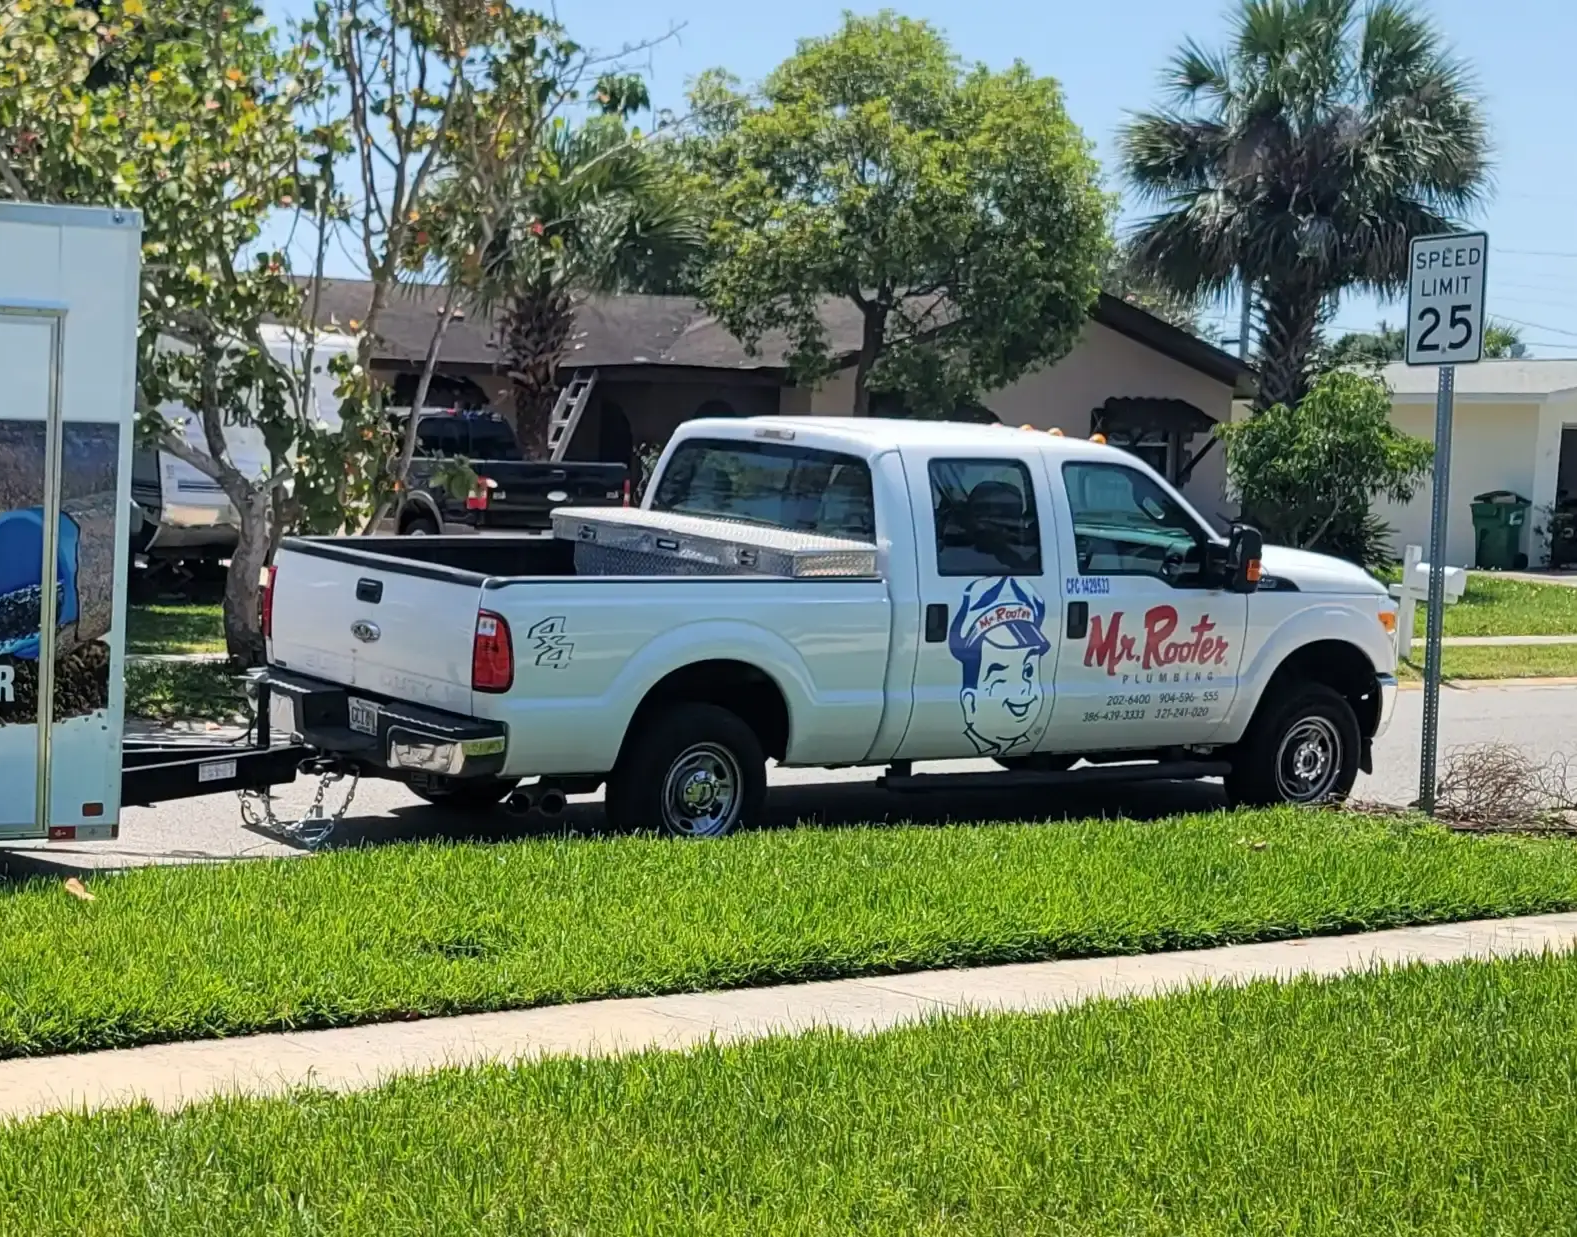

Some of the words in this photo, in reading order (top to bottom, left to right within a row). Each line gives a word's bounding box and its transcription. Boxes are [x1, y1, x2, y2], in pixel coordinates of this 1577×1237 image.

[1416, 247, 1481, 270] SPEED
[1421, 275, 1472, 297] LIMIT
[1415, 303, 1473, 352] 25
[1142, 604, 1229, 670] Rooter
[1122, 671, 1215, 684] PLUMBING
[1106, 694, 1151, 706] 202-6400
[1082, 709, 1146, 722] 386-439-3333
